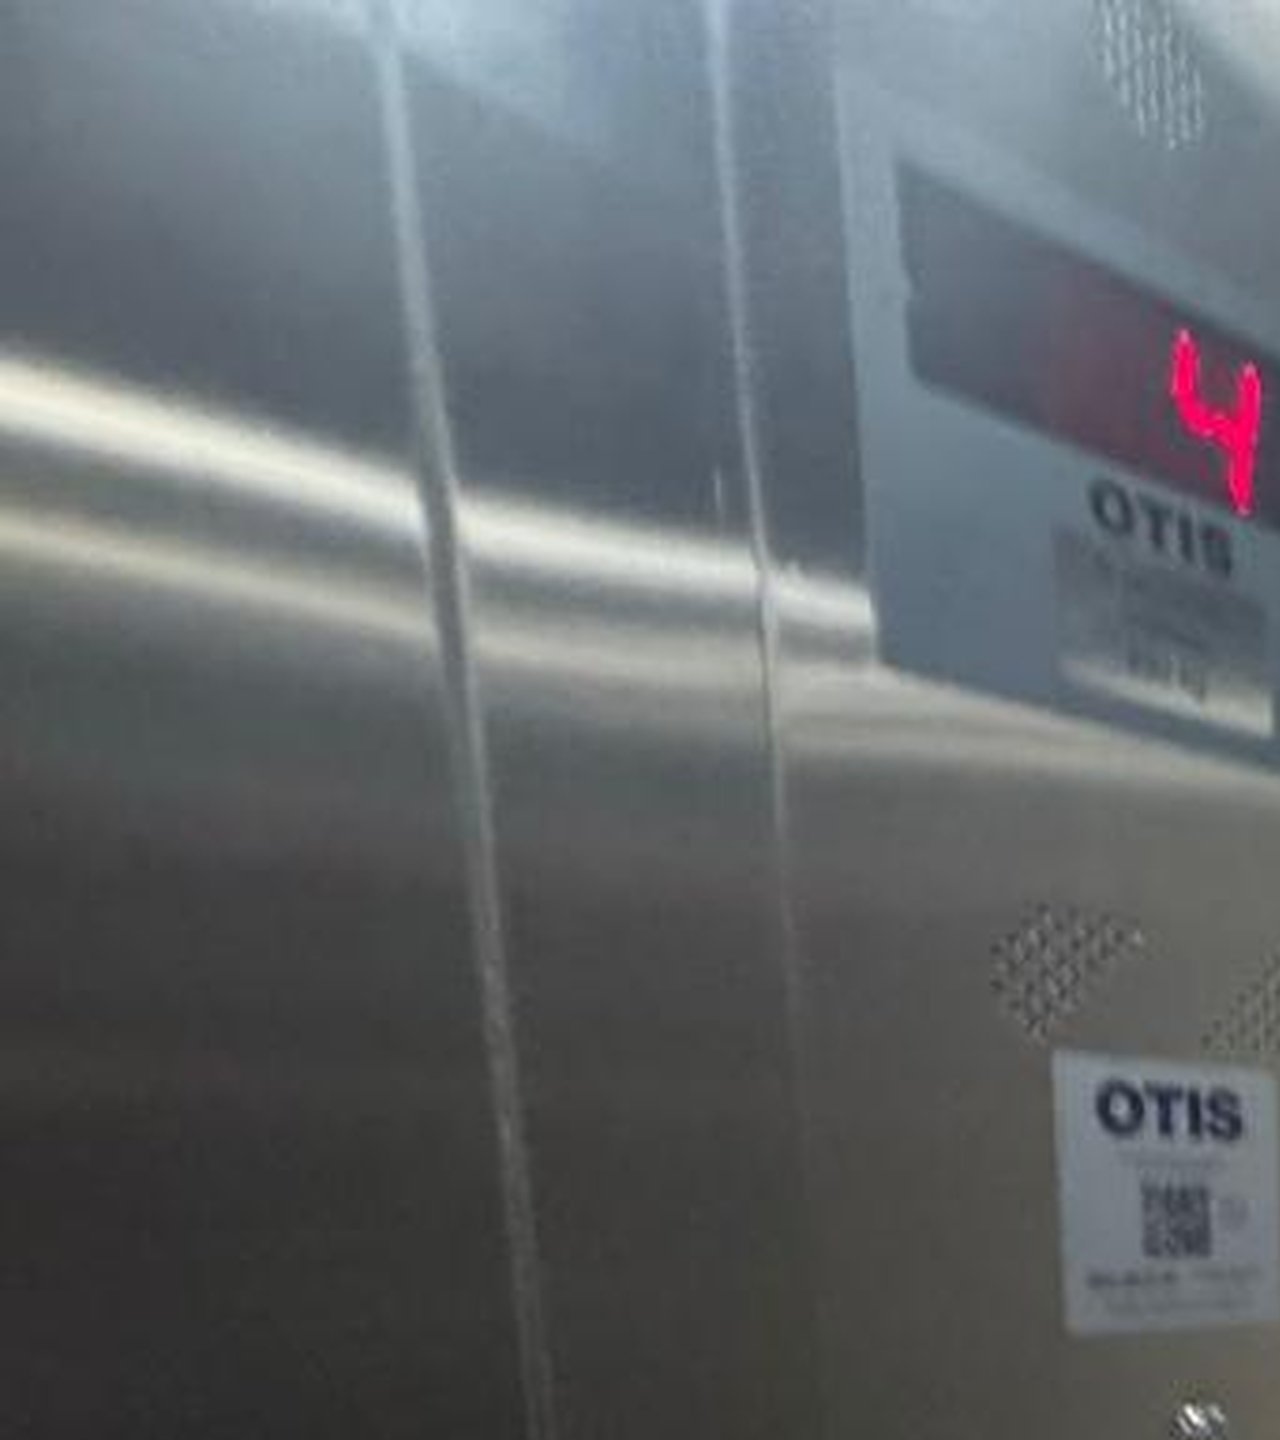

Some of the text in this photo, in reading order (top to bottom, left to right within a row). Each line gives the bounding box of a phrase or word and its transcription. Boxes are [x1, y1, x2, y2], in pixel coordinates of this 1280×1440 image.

[1170, 328, 1262, 519] 4
[1088, 479, 1235, 580] OTIS
[1095, 1078, 1244, 1143] OTIS
